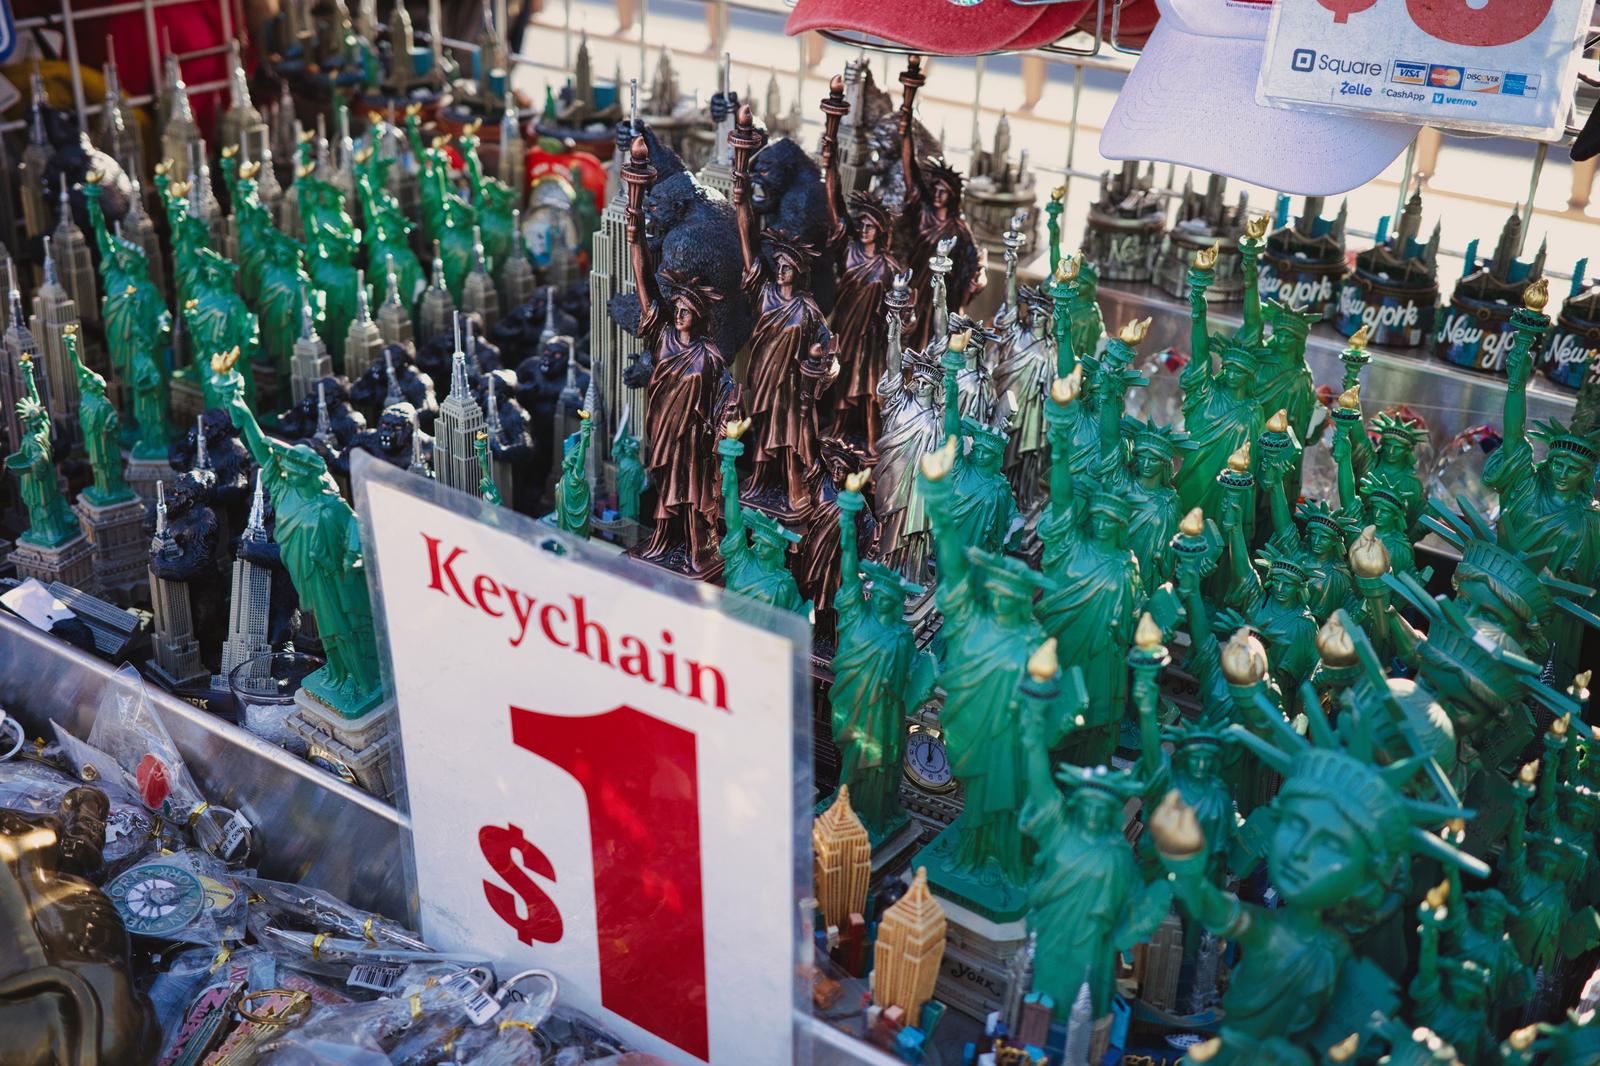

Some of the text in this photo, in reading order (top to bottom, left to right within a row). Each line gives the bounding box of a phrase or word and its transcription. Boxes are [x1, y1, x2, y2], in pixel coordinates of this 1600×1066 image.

[1319, 54, 1382, 76] Square
[1400, 68, 1421, 78] VISA
[1466, 73, 1500, 82] DISCOVER
[1340, 81, 1373, 96] Zelle
[1386, 88, 1425, 101] CashApp
[1446, 97, 1477, 107] venmo
[1438, 314, 1483, 344] New
[1545, 333, 1590, 363] New
[419, 532, 734, 714] Keychain
[478, 704, 710, 1064] $1
